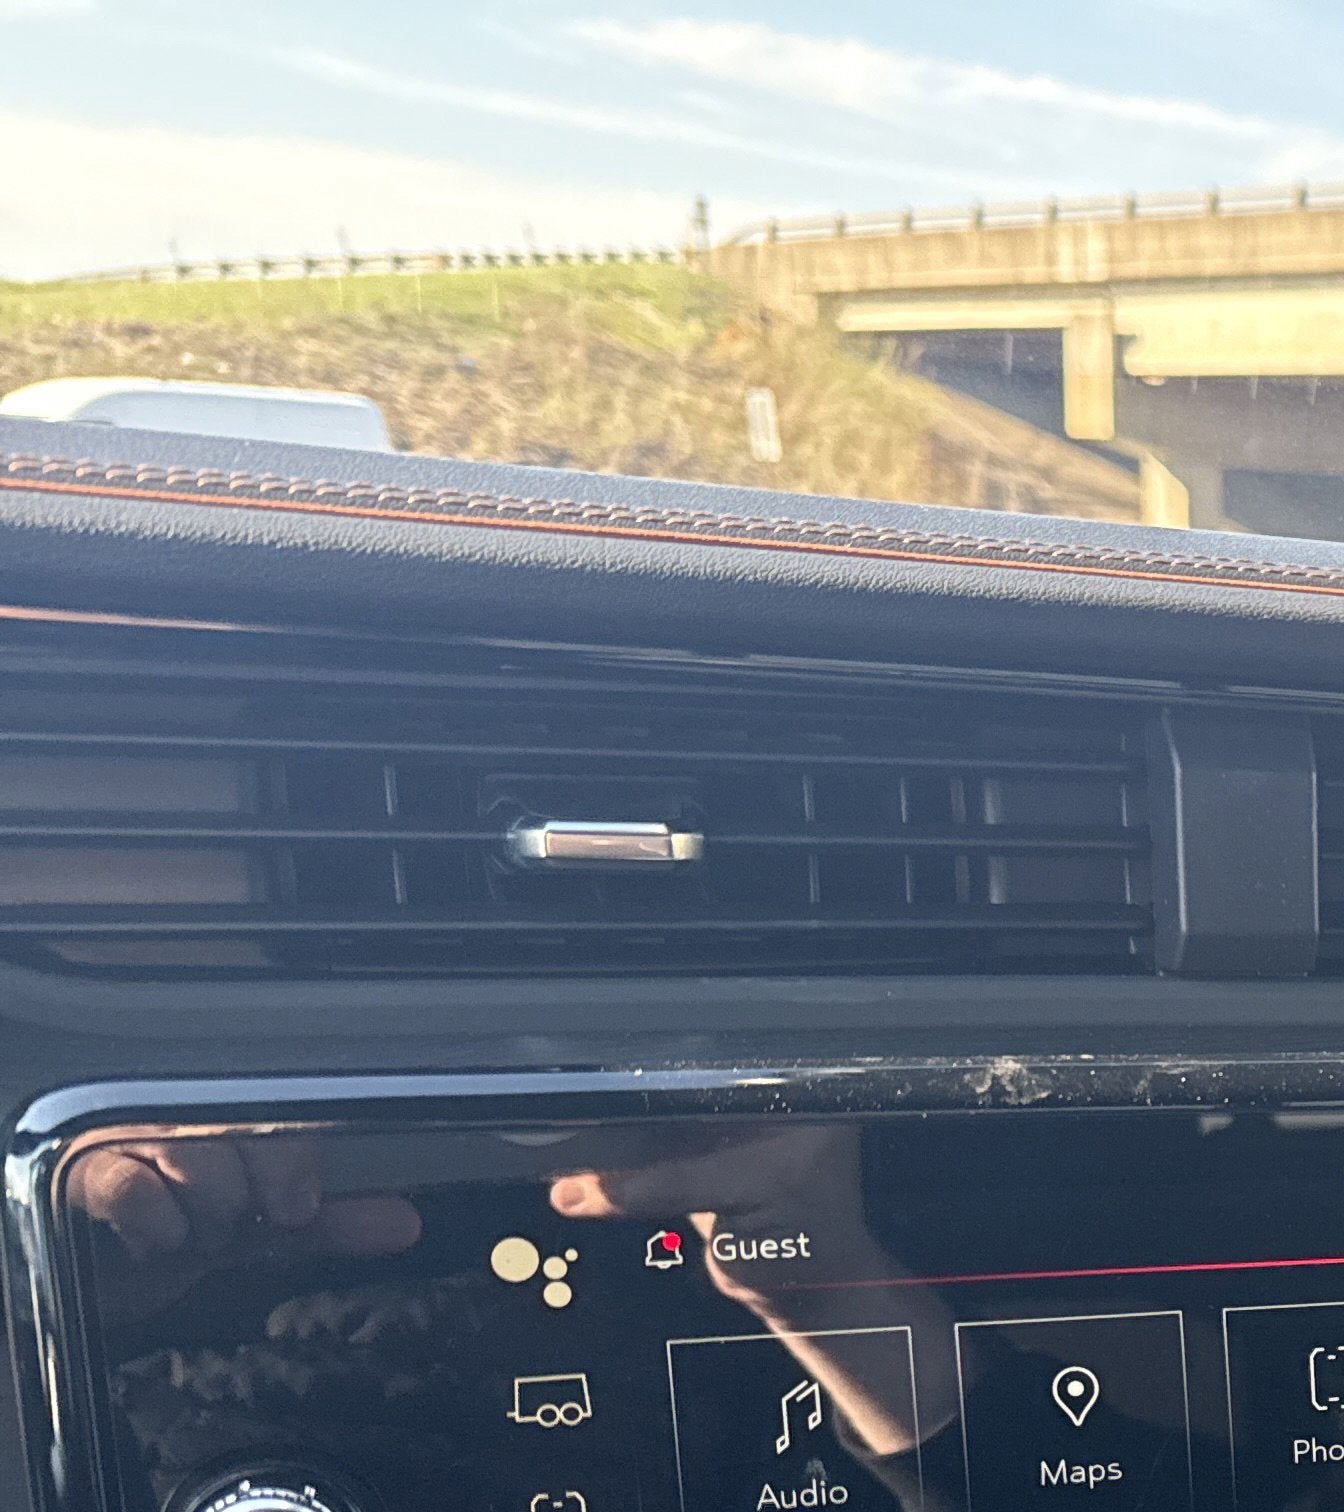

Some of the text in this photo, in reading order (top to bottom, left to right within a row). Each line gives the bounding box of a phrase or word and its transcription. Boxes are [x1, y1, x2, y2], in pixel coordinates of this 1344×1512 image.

[713, 1232, 811, 1263] Guest
[1040, 1458, 1124, 1490] Maps
[757, 1478, 849, 1512] Audio
